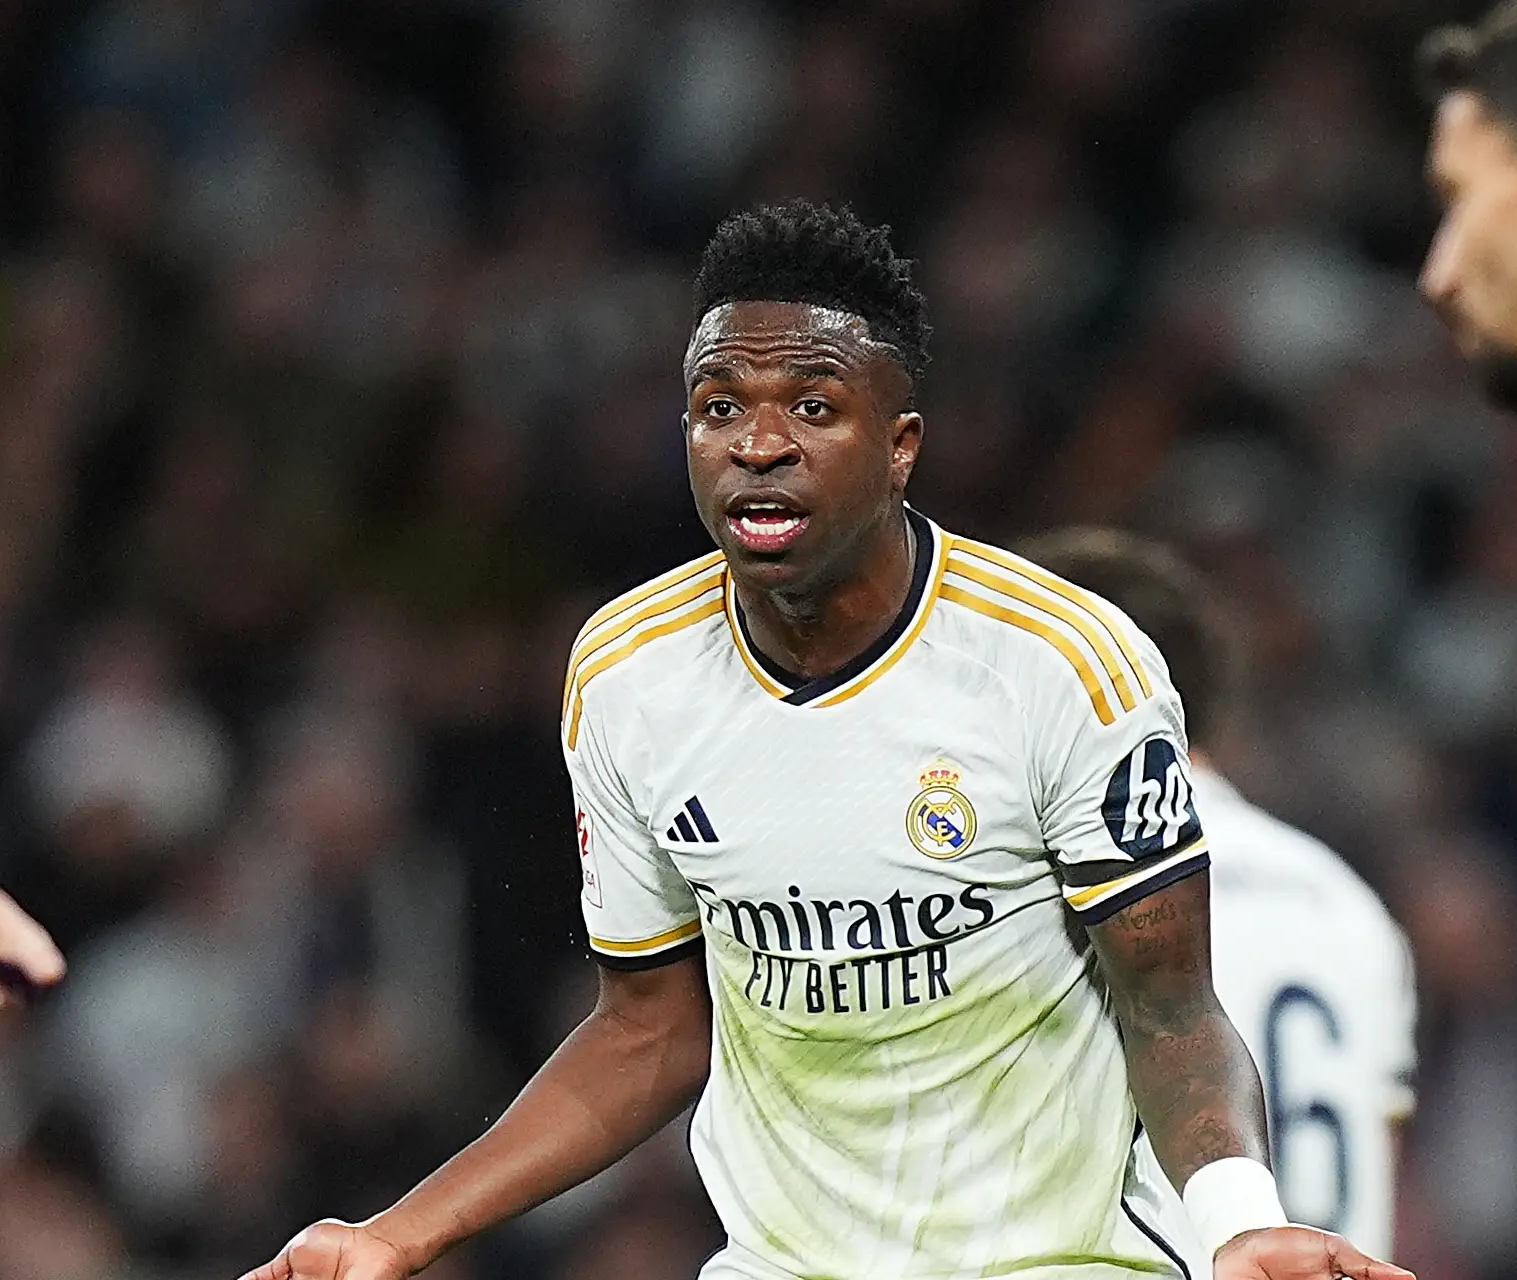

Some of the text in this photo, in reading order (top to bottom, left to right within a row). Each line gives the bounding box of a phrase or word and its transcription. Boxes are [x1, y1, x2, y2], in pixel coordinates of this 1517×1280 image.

[1120, 740, 1191, 850] hp
[687, 878, 995, 951] Emirates
[744, 943, 952, 1013] FLY BETTER
[1263, 983, 1350, 1234] 6
